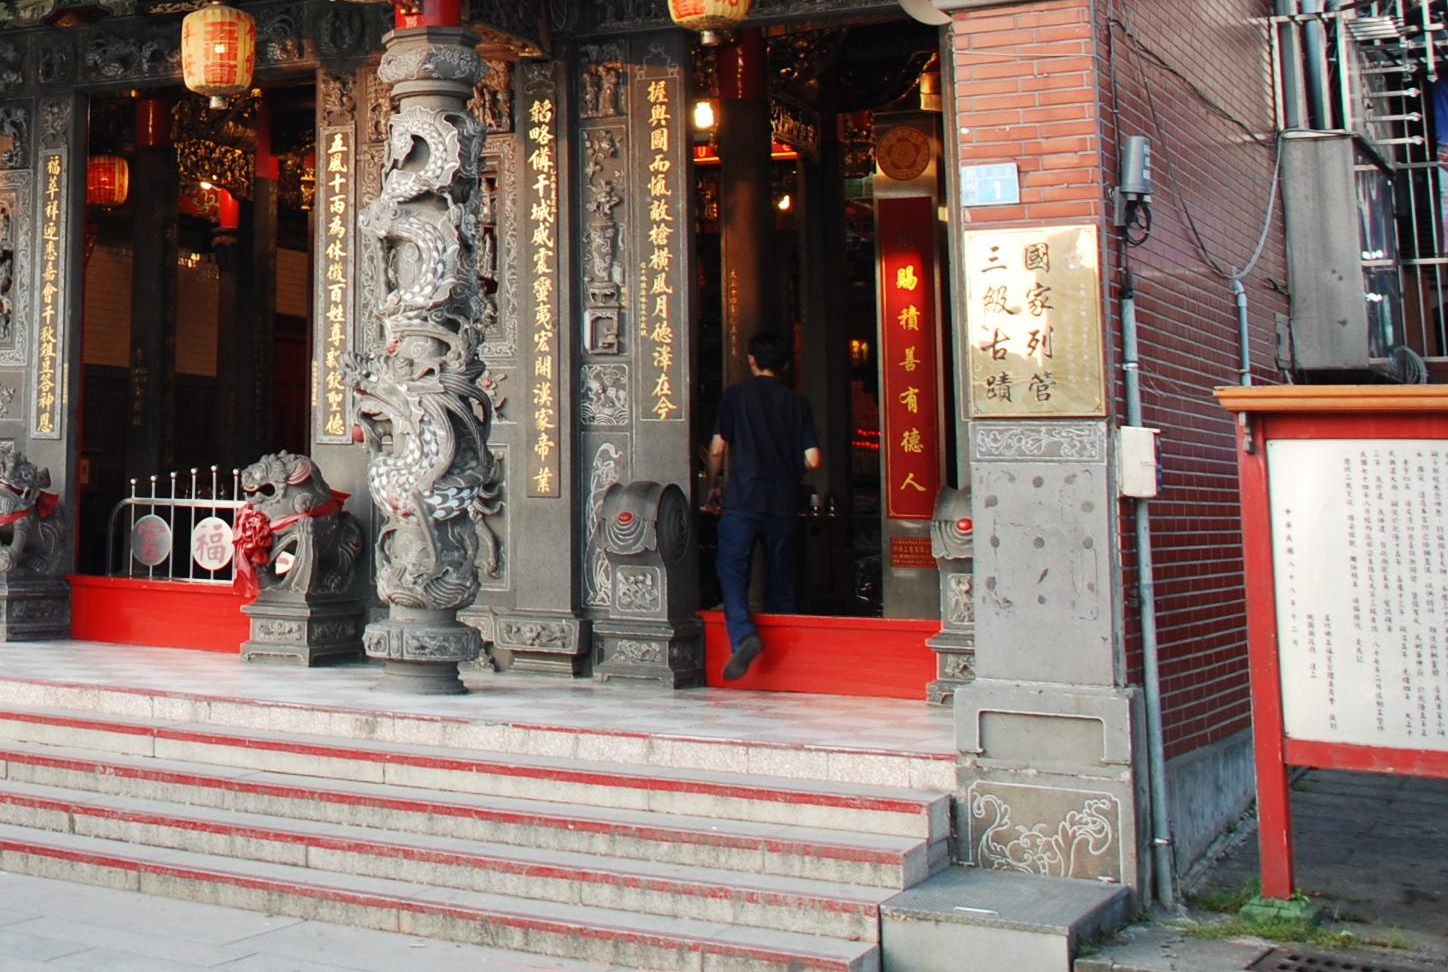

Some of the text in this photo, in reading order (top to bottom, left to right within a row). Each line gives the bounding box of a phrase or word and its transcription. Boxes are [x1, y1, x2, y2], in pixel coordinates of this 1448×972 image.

[980, 245, 1022, 404] 三級古蹟
[1023, 241, 1057, 403] 國家列管
[195, 523, 227, 563] 福
